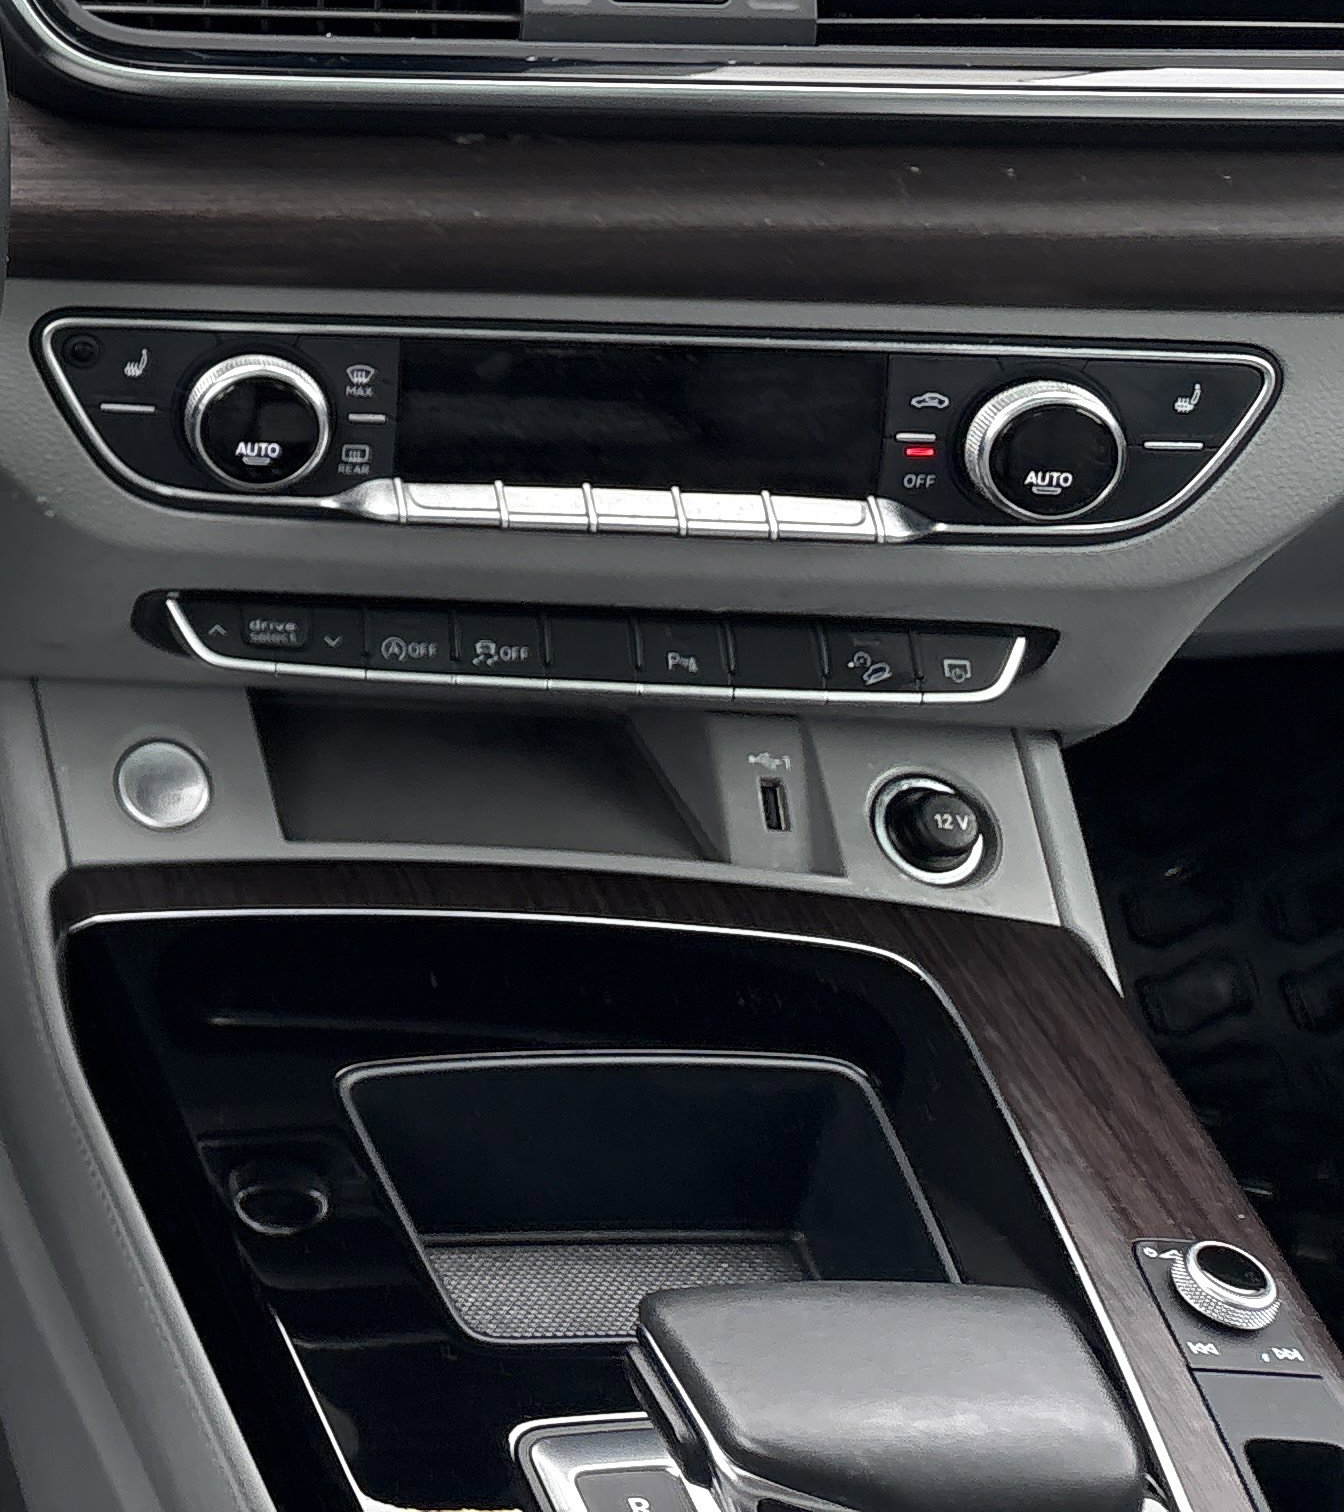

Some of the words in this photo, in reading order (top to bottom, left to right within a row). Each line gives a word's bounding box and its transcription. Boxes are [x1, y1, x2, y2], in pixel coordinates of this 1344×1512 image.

[345, 385, 374, 397] MAX
[234, 441, 282, 458] AUTO
[337, 464, 370, 475] REAR
[903, 473, 937, 489] OFF
[1023, 470, 1073, 488] AUTO
[249, 618, 297, 632] drive
[408, 643, 438, 658] OFF
[499, 645, 530, 661] OFF
[933, 813, 954, 830] 12
[955, 815, 969, 831] V
[628, 1497, 650, 1512] R
